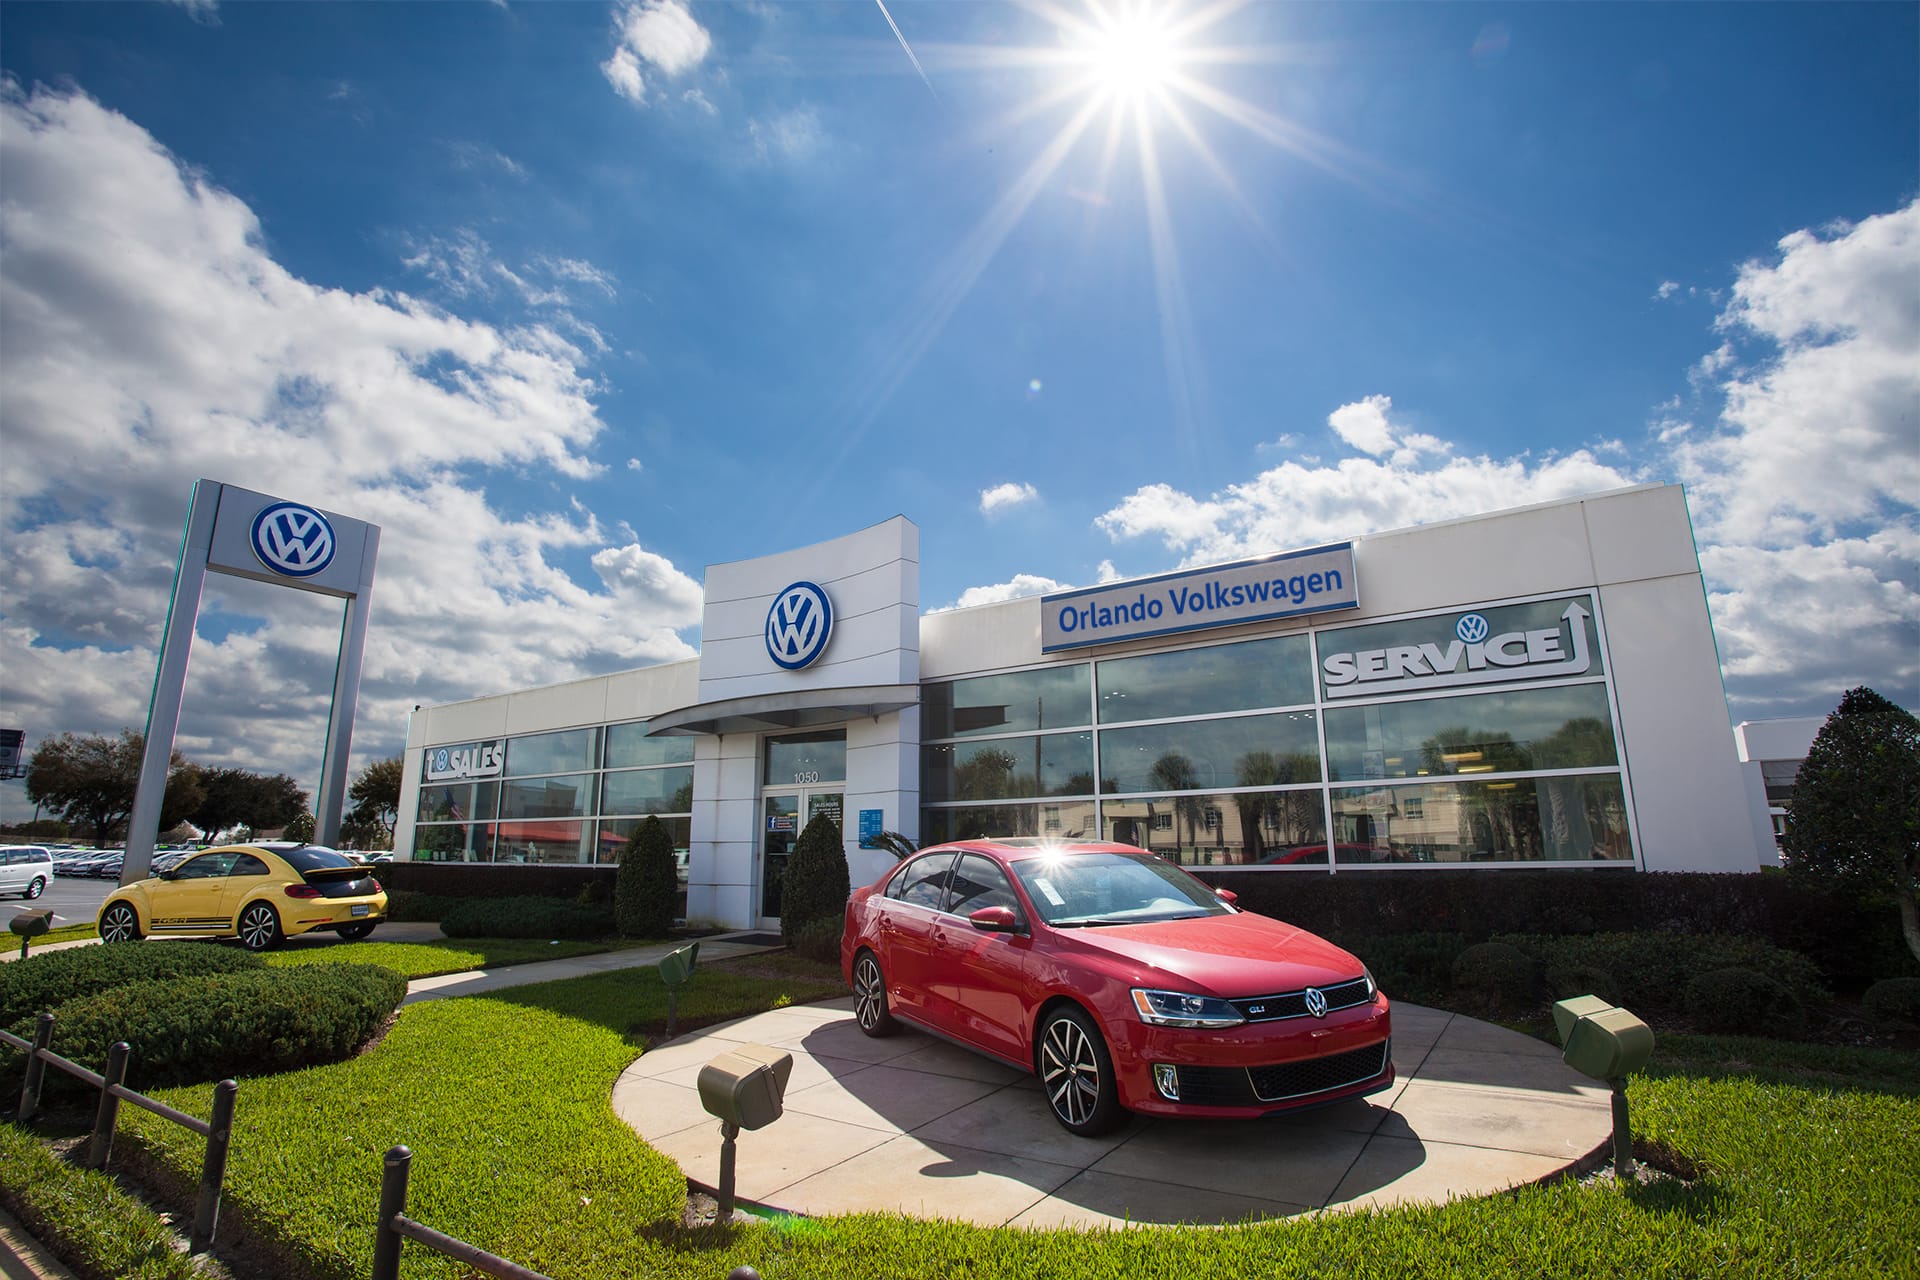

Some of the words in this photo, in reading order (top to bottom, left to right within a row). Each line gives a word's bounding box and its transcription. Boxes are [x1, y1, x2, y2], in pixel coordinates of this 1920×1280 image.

[1058, 594, 1163, 633] Orlando
[1169, 569, 1343, 615] Volkswagen
[1323, 627, 1567, 686] SERVICE
[450, 745, 503, 778] SALES
[794, 771, 819, 784] 1050
